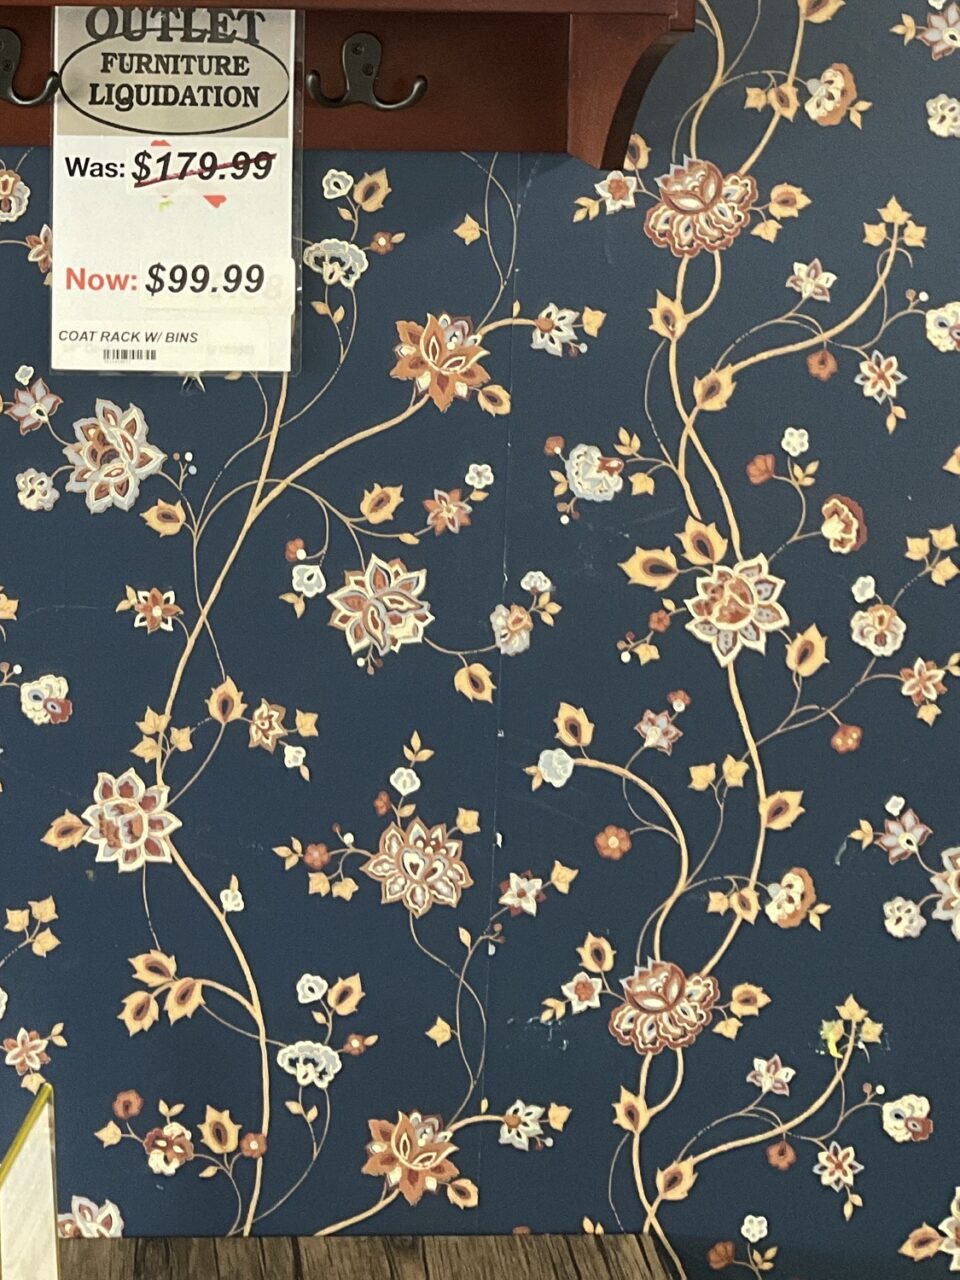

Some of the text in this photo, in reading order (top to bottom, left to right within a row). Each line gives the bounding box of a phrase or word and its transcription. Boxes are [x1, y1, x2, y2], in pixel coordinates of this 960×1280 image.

[85, 7, 265, 44] OUTLET
[100, 51, 250, 76] FURNITURE
[88, 83, 260, 111] LIQUIDATION
[65, 150, 276, 182] Was: $179.99
[65, 262, 265, 297] Now: $99.99
[58, 330, 199, 343] COAT RACK W/ BINS
